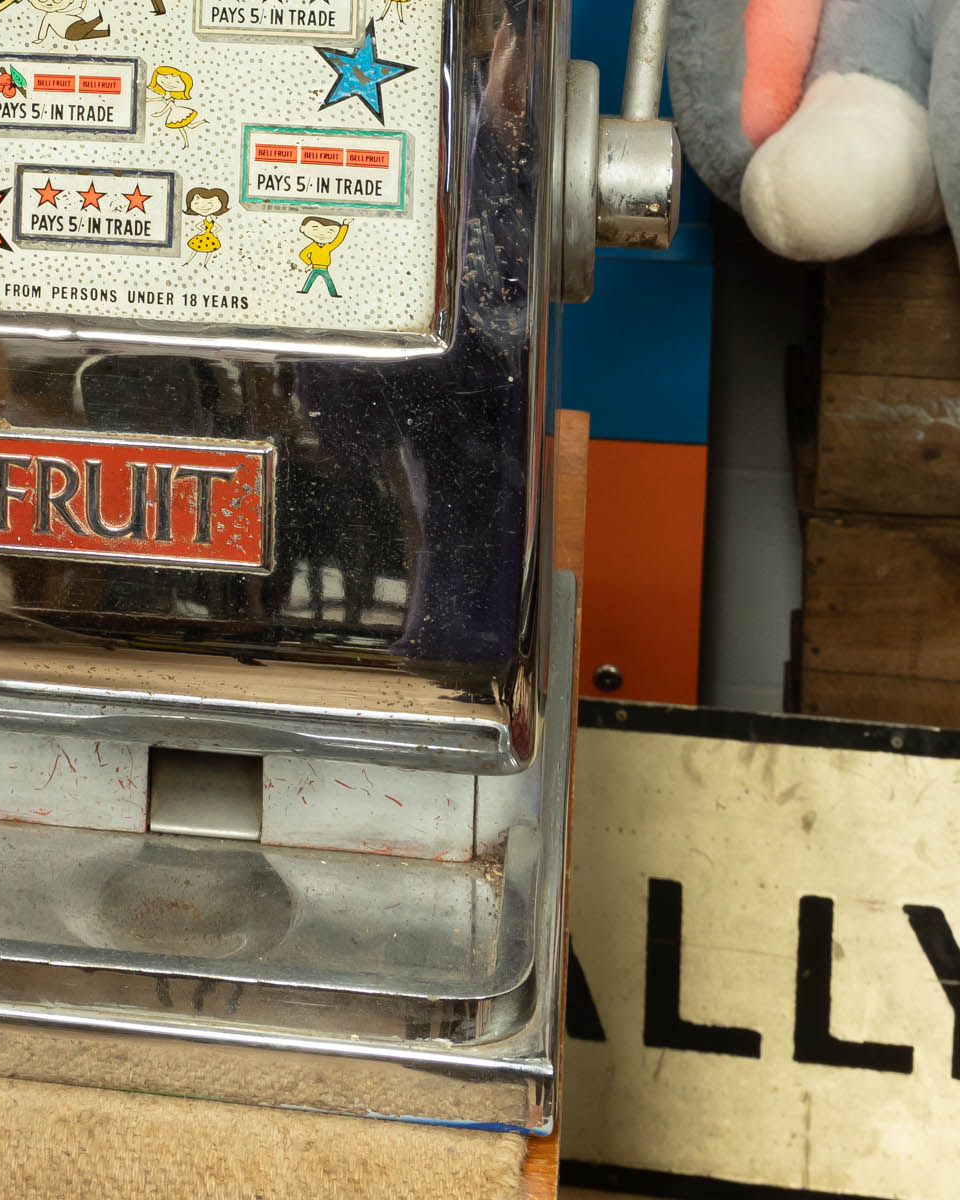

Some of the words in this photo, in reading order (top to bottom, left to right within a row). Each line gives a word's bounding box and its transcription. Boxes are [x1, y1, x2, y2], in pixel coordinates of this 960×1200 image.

[211, 6, 246, 24] PAYS
[270, 8, 284, 25] IN
[289, 9, 337, 27] TRADE
[50, 104, 64, 121] IN
[68, 104, 114, 122] TRADE
[257, 173, 291, 191] PAYS
[316, 177, 330, 194] IN
[335, 178, 383, 196] TRADE
[31, 214, 64, 231] PAYS
[87, 217, 101, 234] IN
[105, 218, 151, 236] TRADE
[4, 283, 42, 299] FROM
[51, 287, 118, 303] PERSONS
[127, 290, 175, 306] UNDER
[182, 293, 198, 307] 18
[202, 293, 250, 310] YEARS
